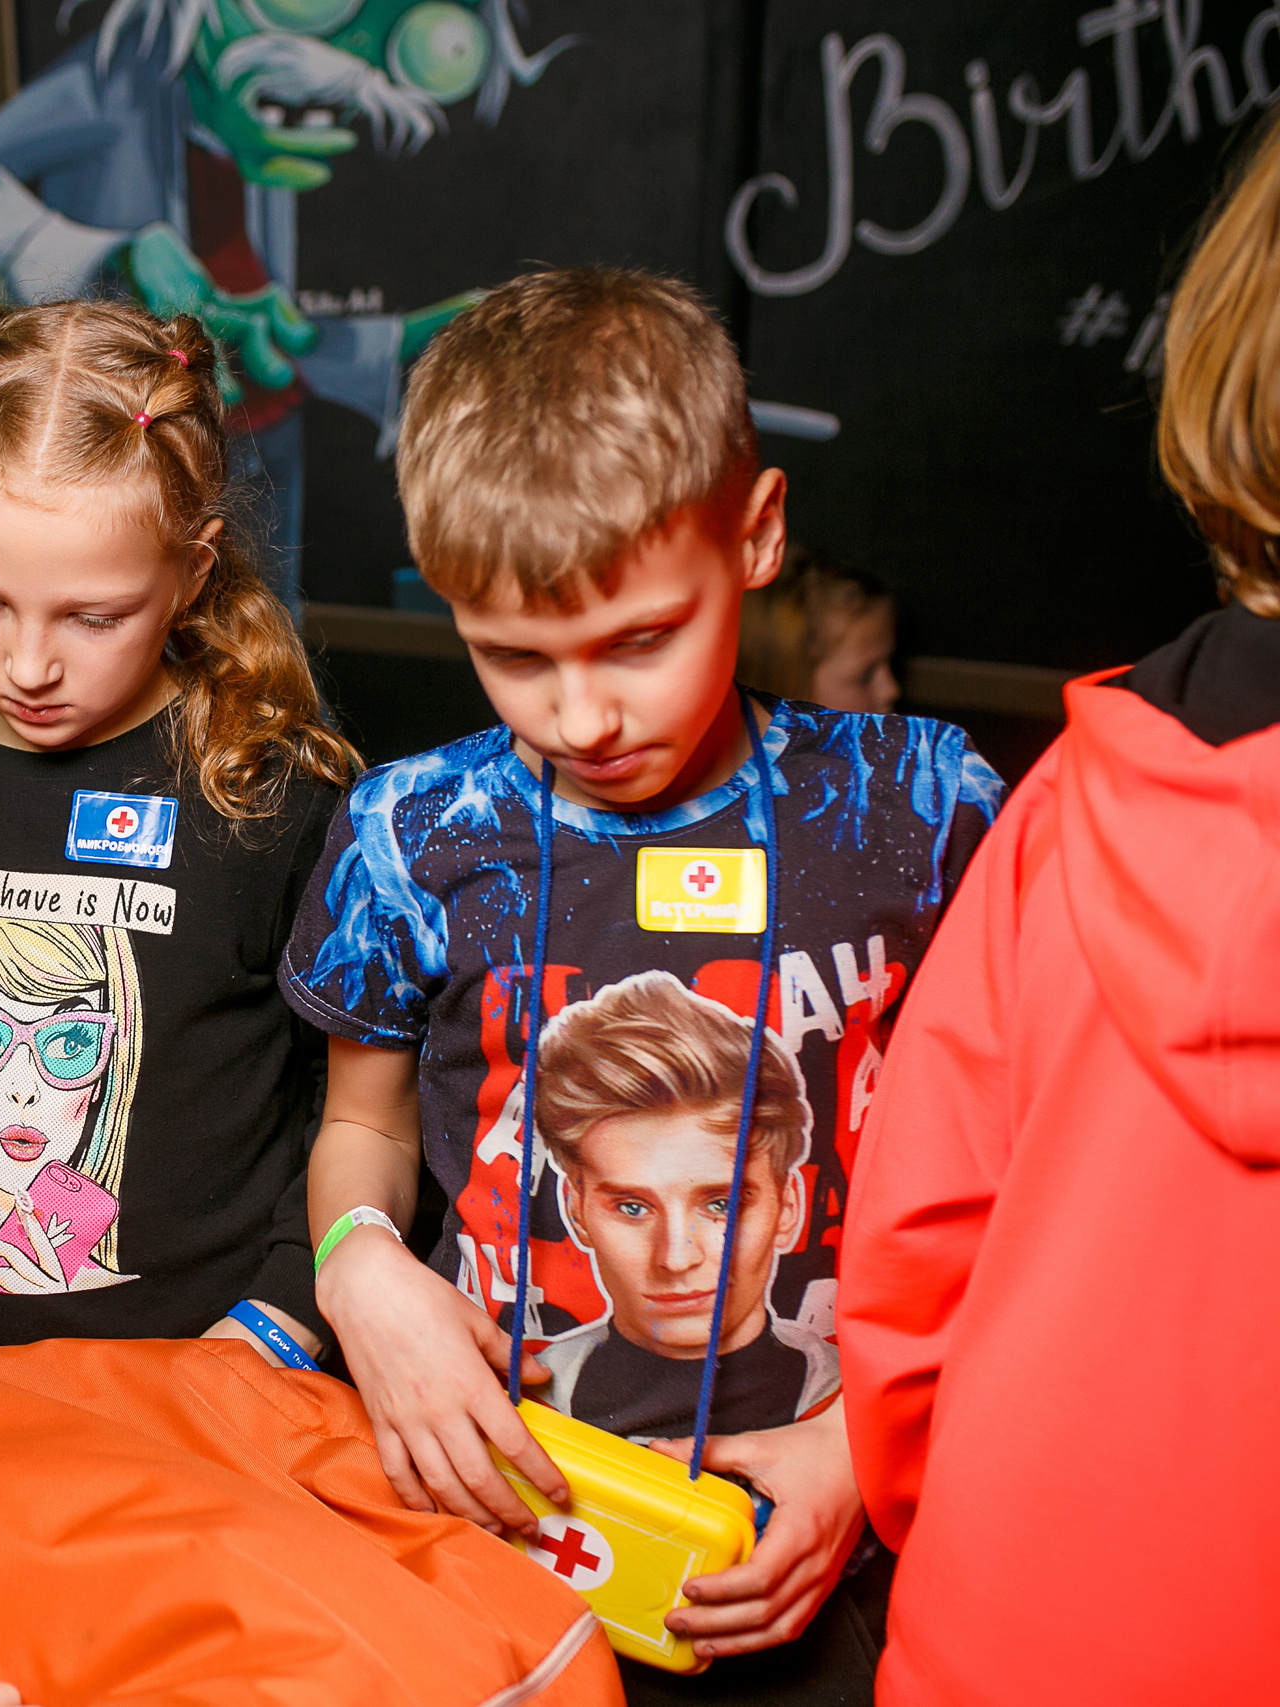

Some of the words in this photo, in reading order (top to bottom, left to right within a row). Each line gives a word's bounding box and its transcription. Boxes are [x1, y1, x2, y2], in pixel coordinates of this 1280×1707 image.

[0, 871, 61, 913] have
[75, 890, 98, 917] is
[111, 881, 173, 928] Now
